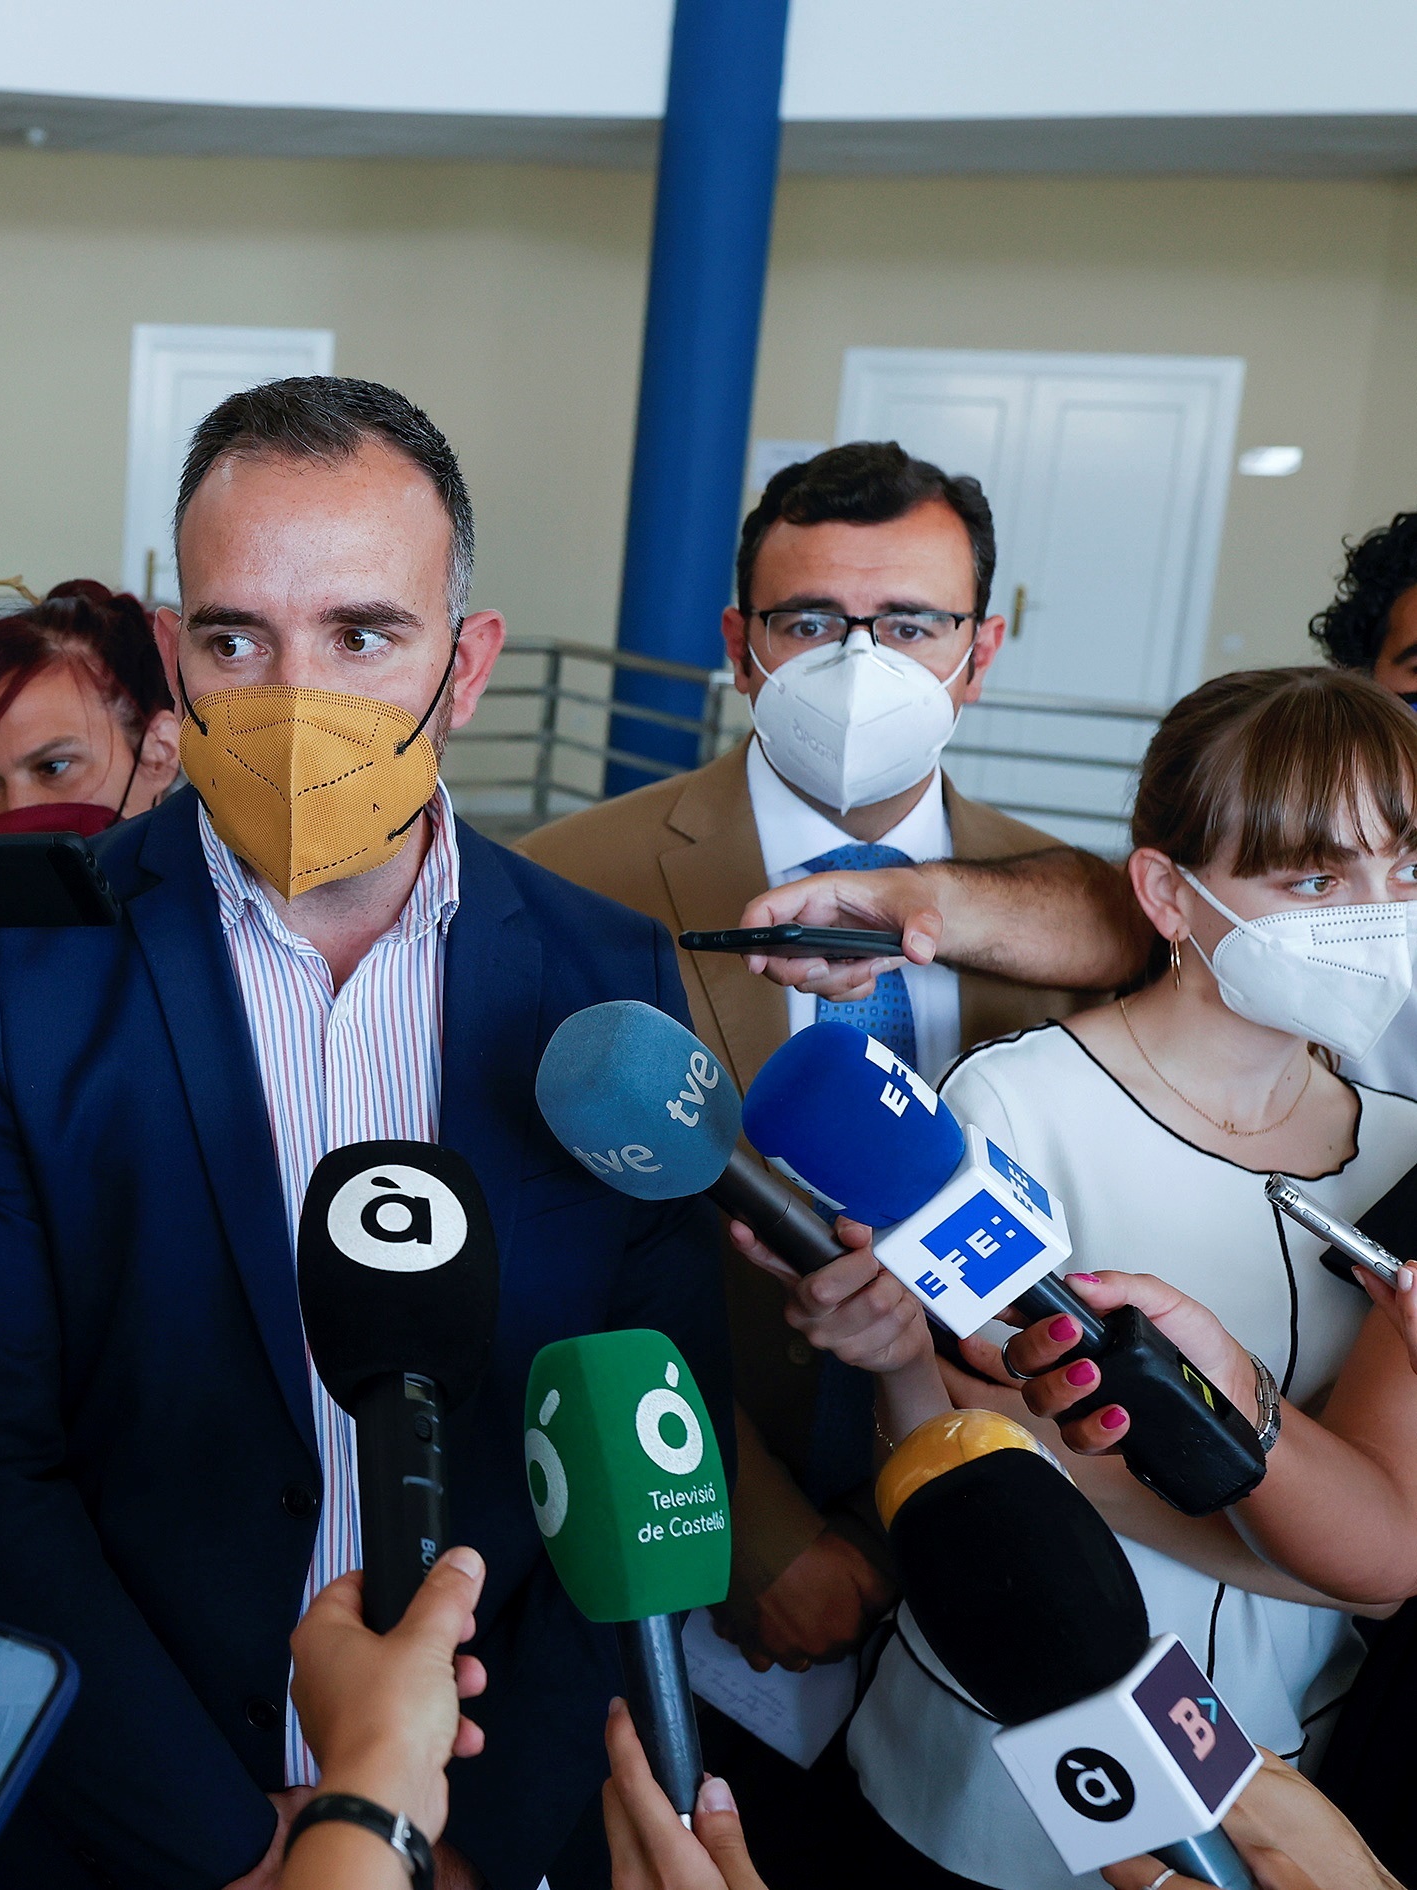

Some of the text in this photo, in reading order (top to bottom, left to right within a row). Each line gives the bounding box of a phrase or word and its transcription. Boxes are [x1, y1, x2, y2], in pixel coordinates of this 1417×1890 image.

[666, 1051, 719, 1127] tve
[572, 1144, 663, 1174] tve
[360, 1176, 433, 1245] à
[647, 1481, 716, 1511] Televisió
[637, 1509, 725, 1543] de Castelló
